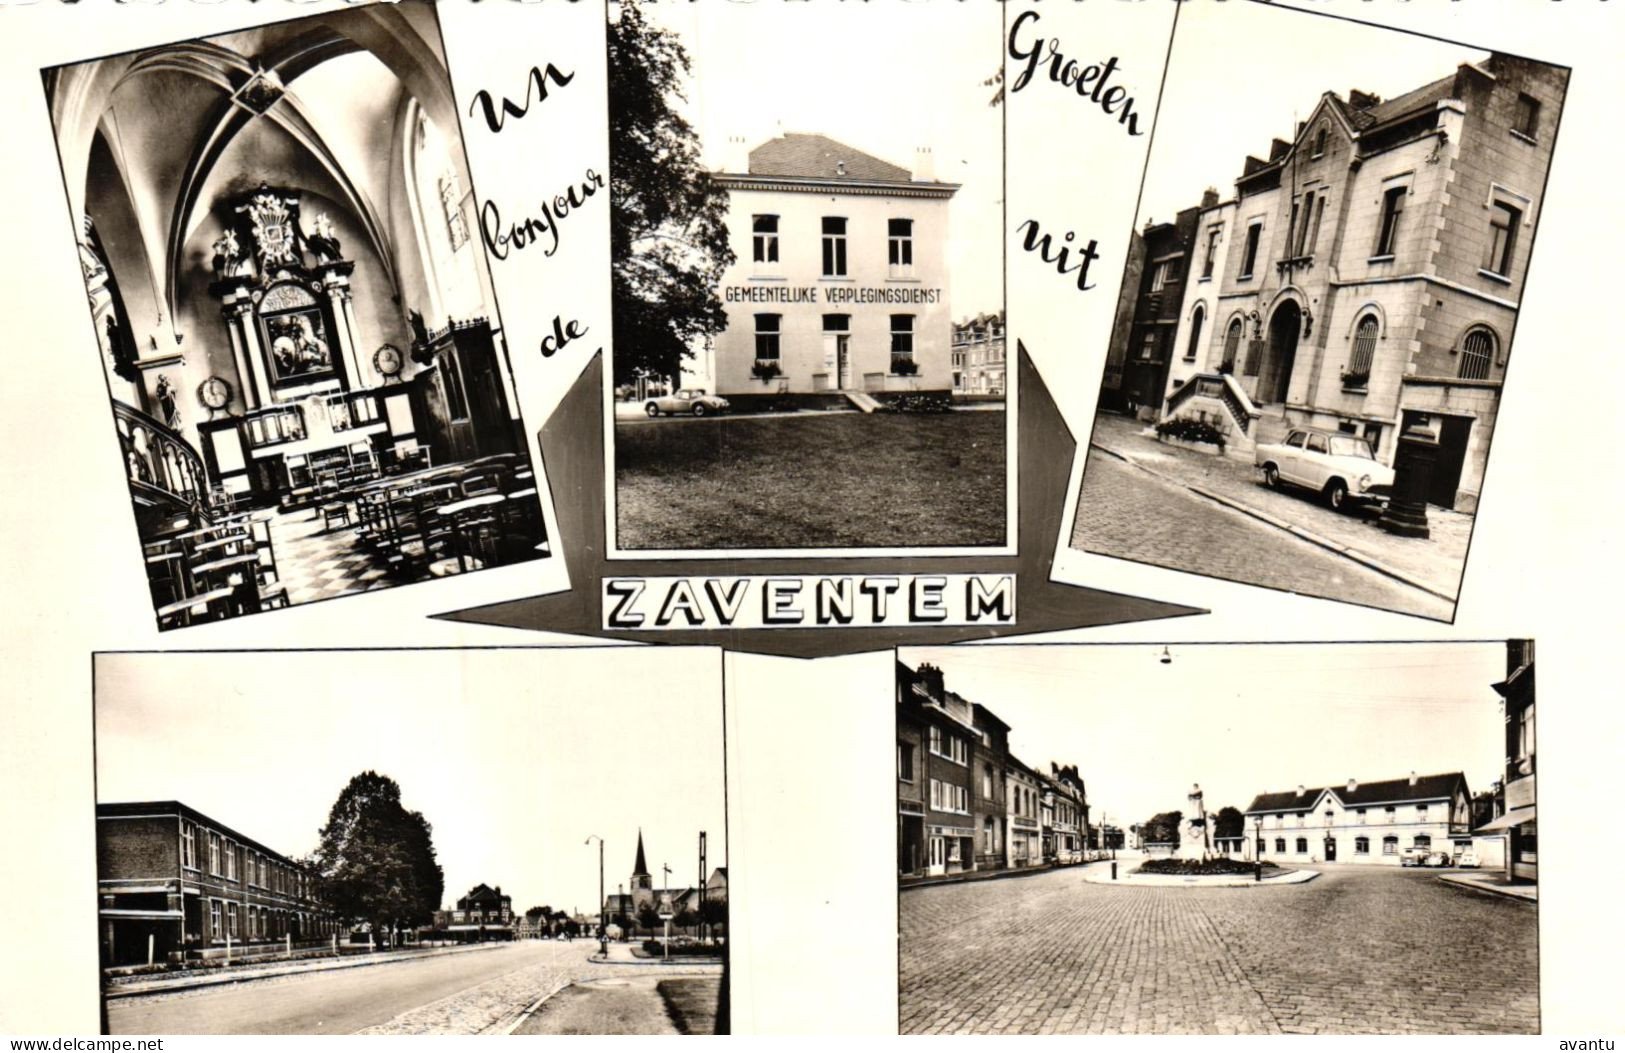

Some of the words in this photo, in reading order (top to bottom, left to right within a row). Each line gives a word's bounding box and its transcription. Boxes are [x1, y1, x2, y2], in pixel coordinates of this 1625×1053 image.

[1008, 10, 1144, 136] Groeten
[482, 168, 605, 261] bonjour
[1016, 219, 1100, 291] uit
[825, 287, 941, 304] VERPLEGINGSDIENST
[540, 315, 589, 358] de
[606, 576, 1013, 627] ZAVENTEM
